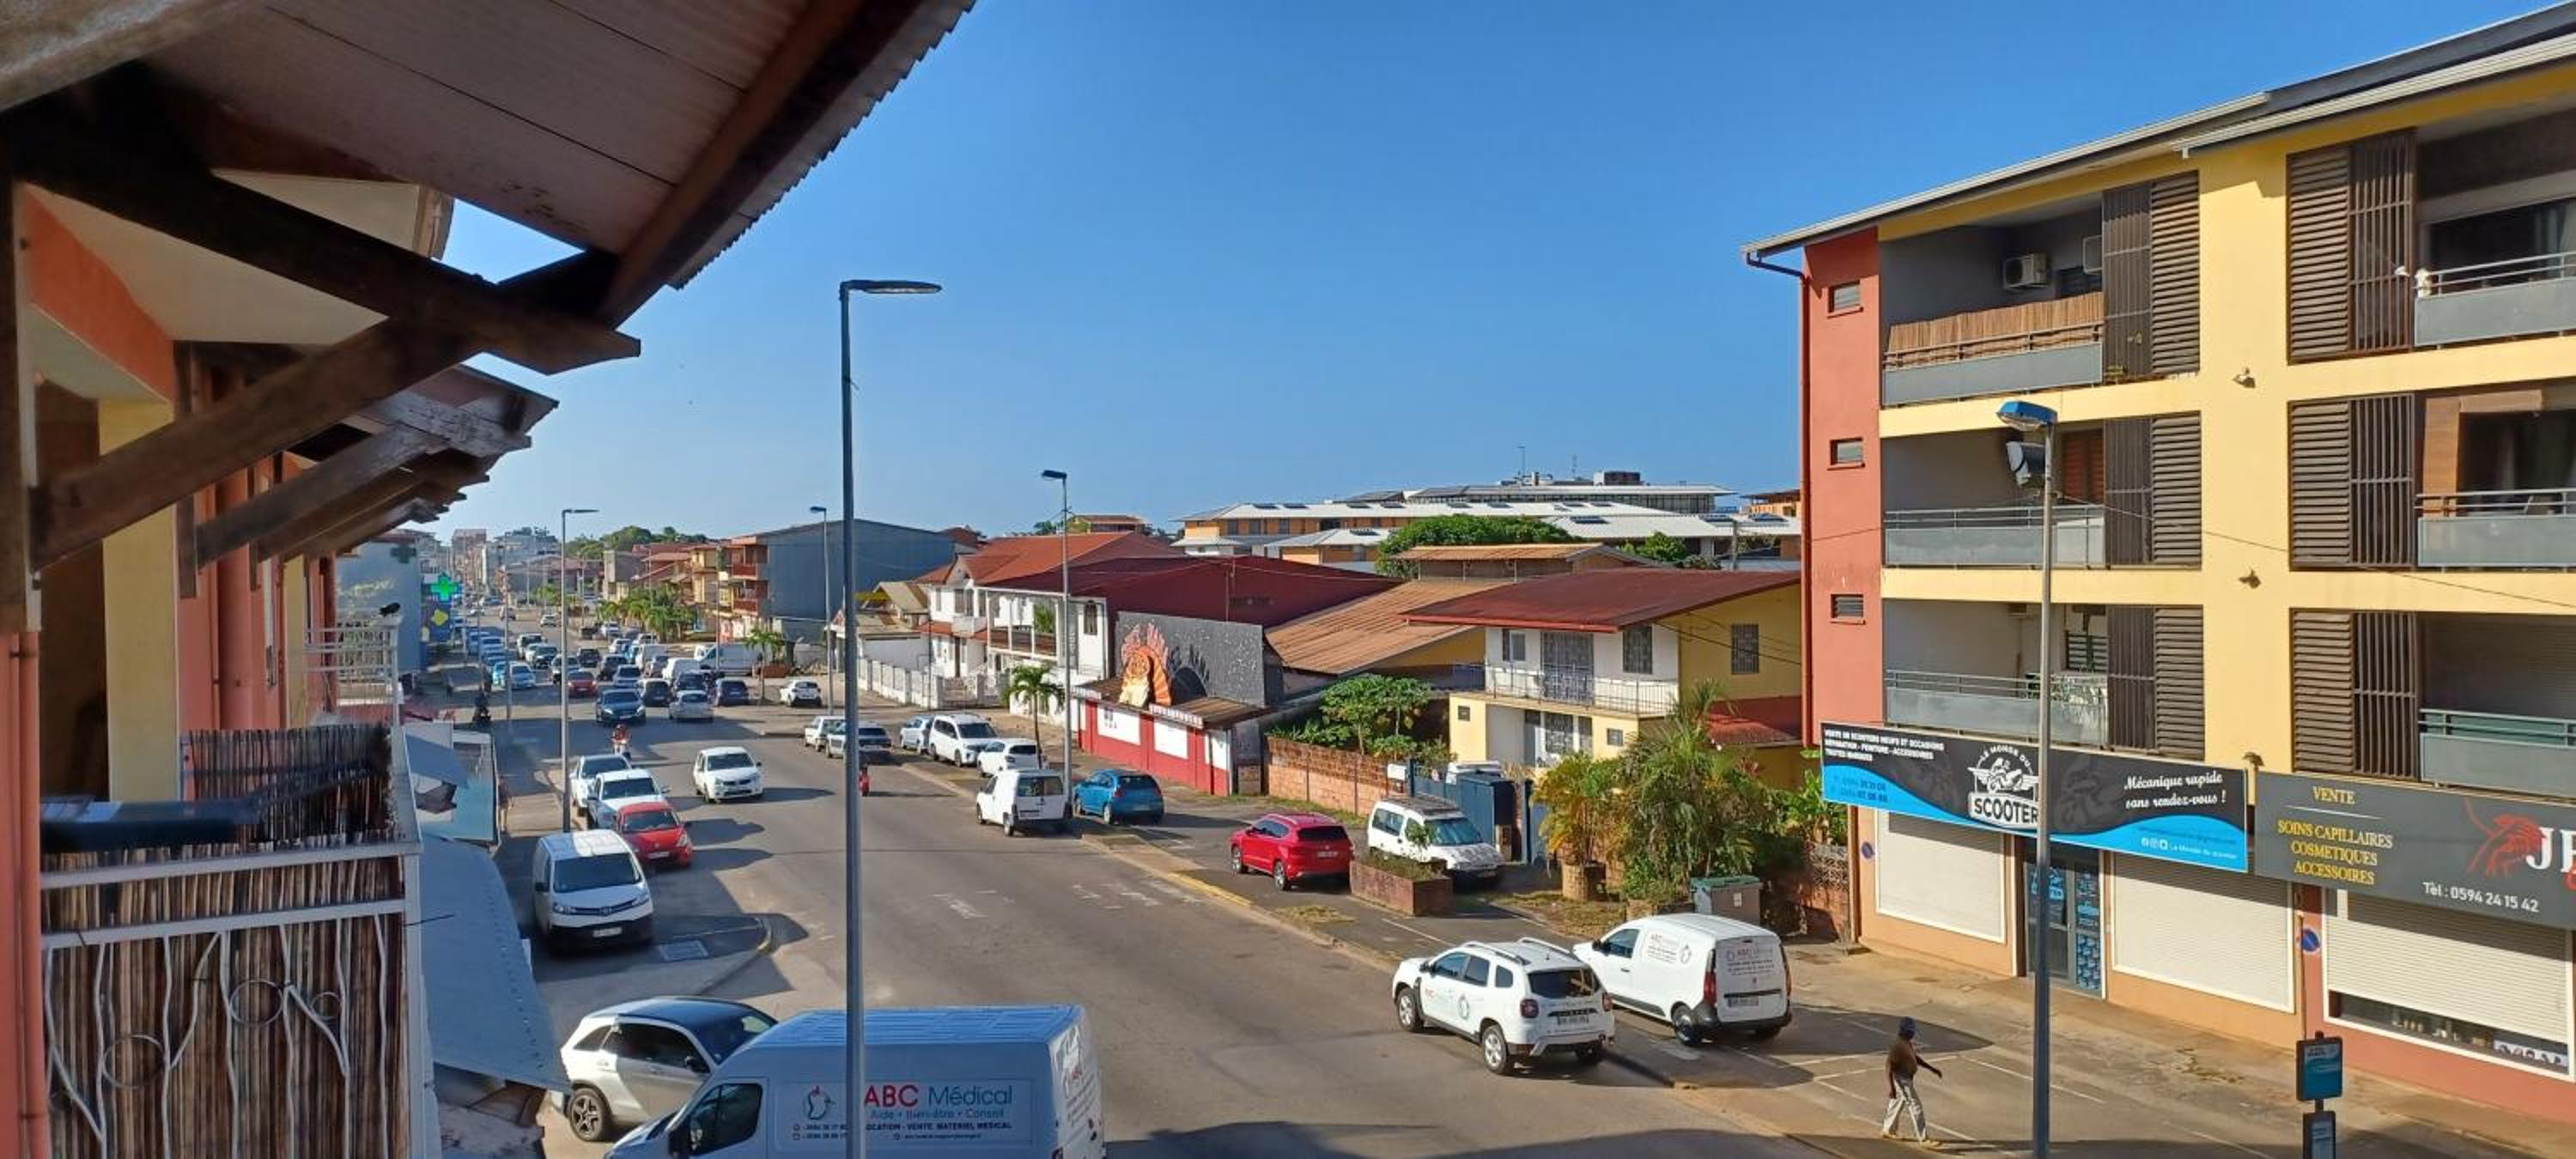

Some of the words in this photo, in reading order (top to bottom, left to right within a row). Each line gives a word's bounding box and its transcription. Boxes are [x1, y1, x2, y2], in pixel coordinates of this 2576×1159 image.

[2123, 775, 2184, 791] Mécanique
[2185, 770, 2223, 789] rapide
[2153, 792, 2218, 807] rendez-vous
[2312, 786, 2355, 804] VENTE
[1974, 798, 2038, 823] SCOOTER
[2277, 819, 2313, 837] SOINS
[2314, 825, 2393, 849] CAPILLAIRES
[2291, 840, 2378, 866] COSMETIQUES
[2293, 859, 2374, 885] ACCESSOIRES
[2450, 886, 2483, 903] 0594
[2485, 891, 2502, 907] 24
[2504, 895, 2518, 909] 15
[2520, 897, 2539, 913] 42
[864, 1084, 919, 1107] ABC
[928, 1084, 1012, 1106] Médical
